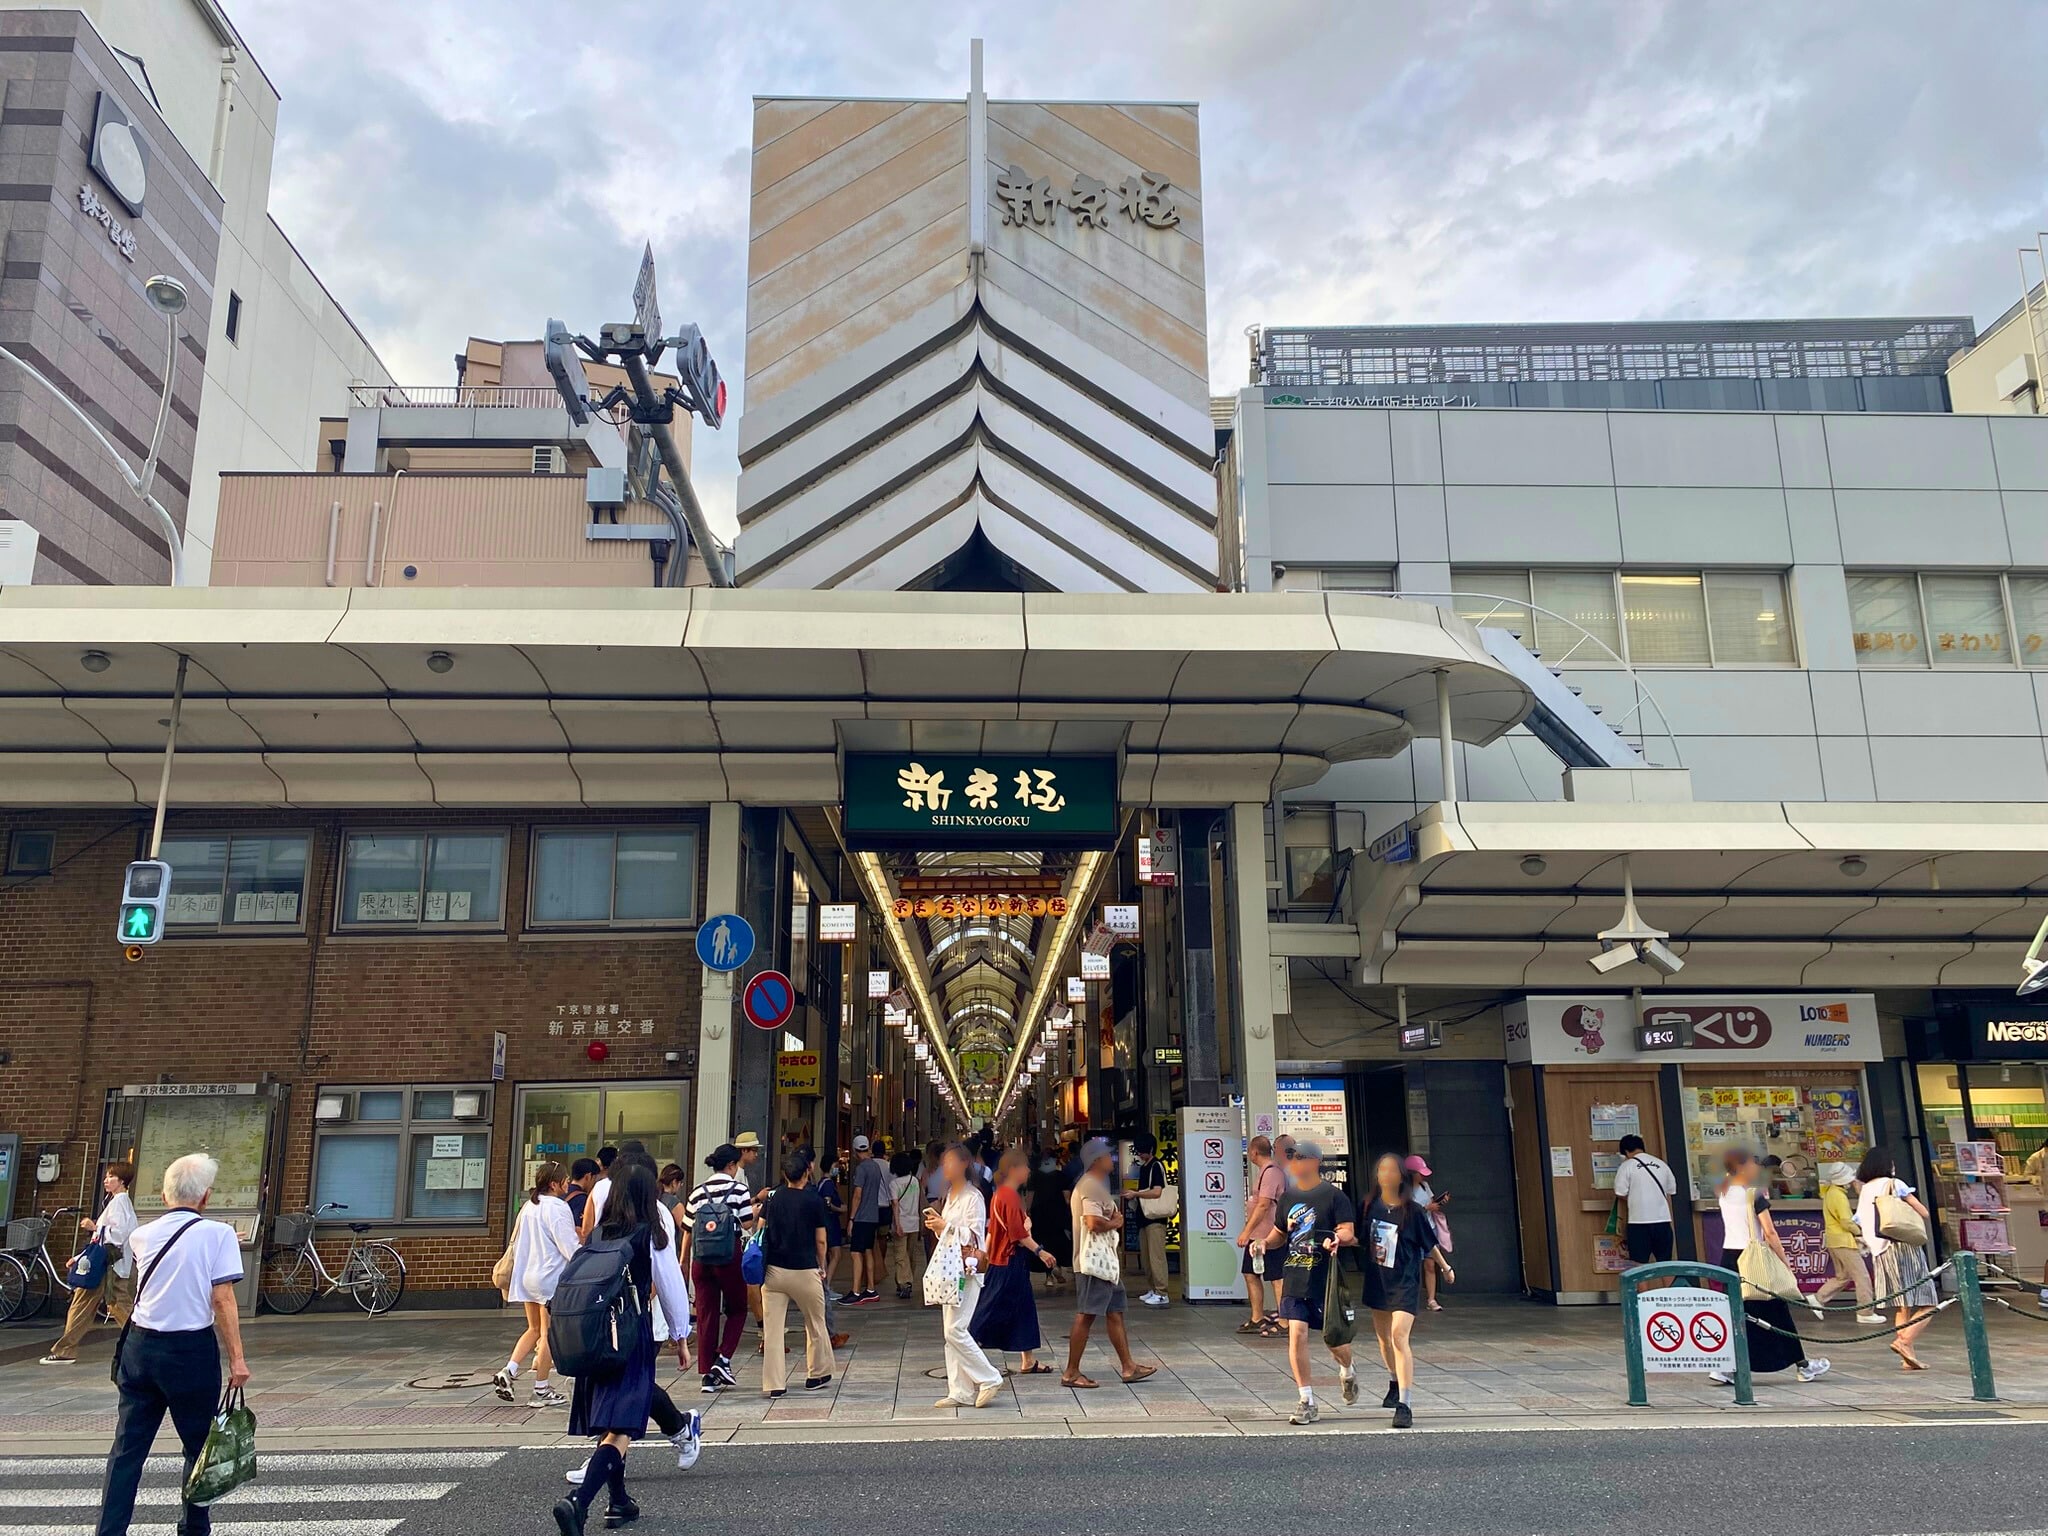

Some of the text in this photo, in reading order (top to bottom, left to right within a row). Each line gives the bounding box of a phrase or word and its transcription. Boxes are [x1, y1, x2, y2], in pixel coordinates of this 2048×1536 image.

[997, 165, 1180, 229] 新京極
[897, 762, 1066, 812] 新京極
[931, 815, 1031, 827] SHINKYOGOKU
[239, 895, 295, 911] 自転車
[556, 1004, 619, 1016] 下京警察署
[1800, 1005, 1828, 1022] LOTO
[549, 1019, 655, 1036] 新京極交番
[1507, 1022, 1528, 1042] 宝くじ
[1653, 1031, 1674, 1044] 宝くじ
[1804, 1033, 1850, 1047] NUMBERS
[779, 1056, 817, 1067] 中古CD
[779, 1078, 816, 1088] Take-J
[1703, 1128, 1726, 1137] 7646
